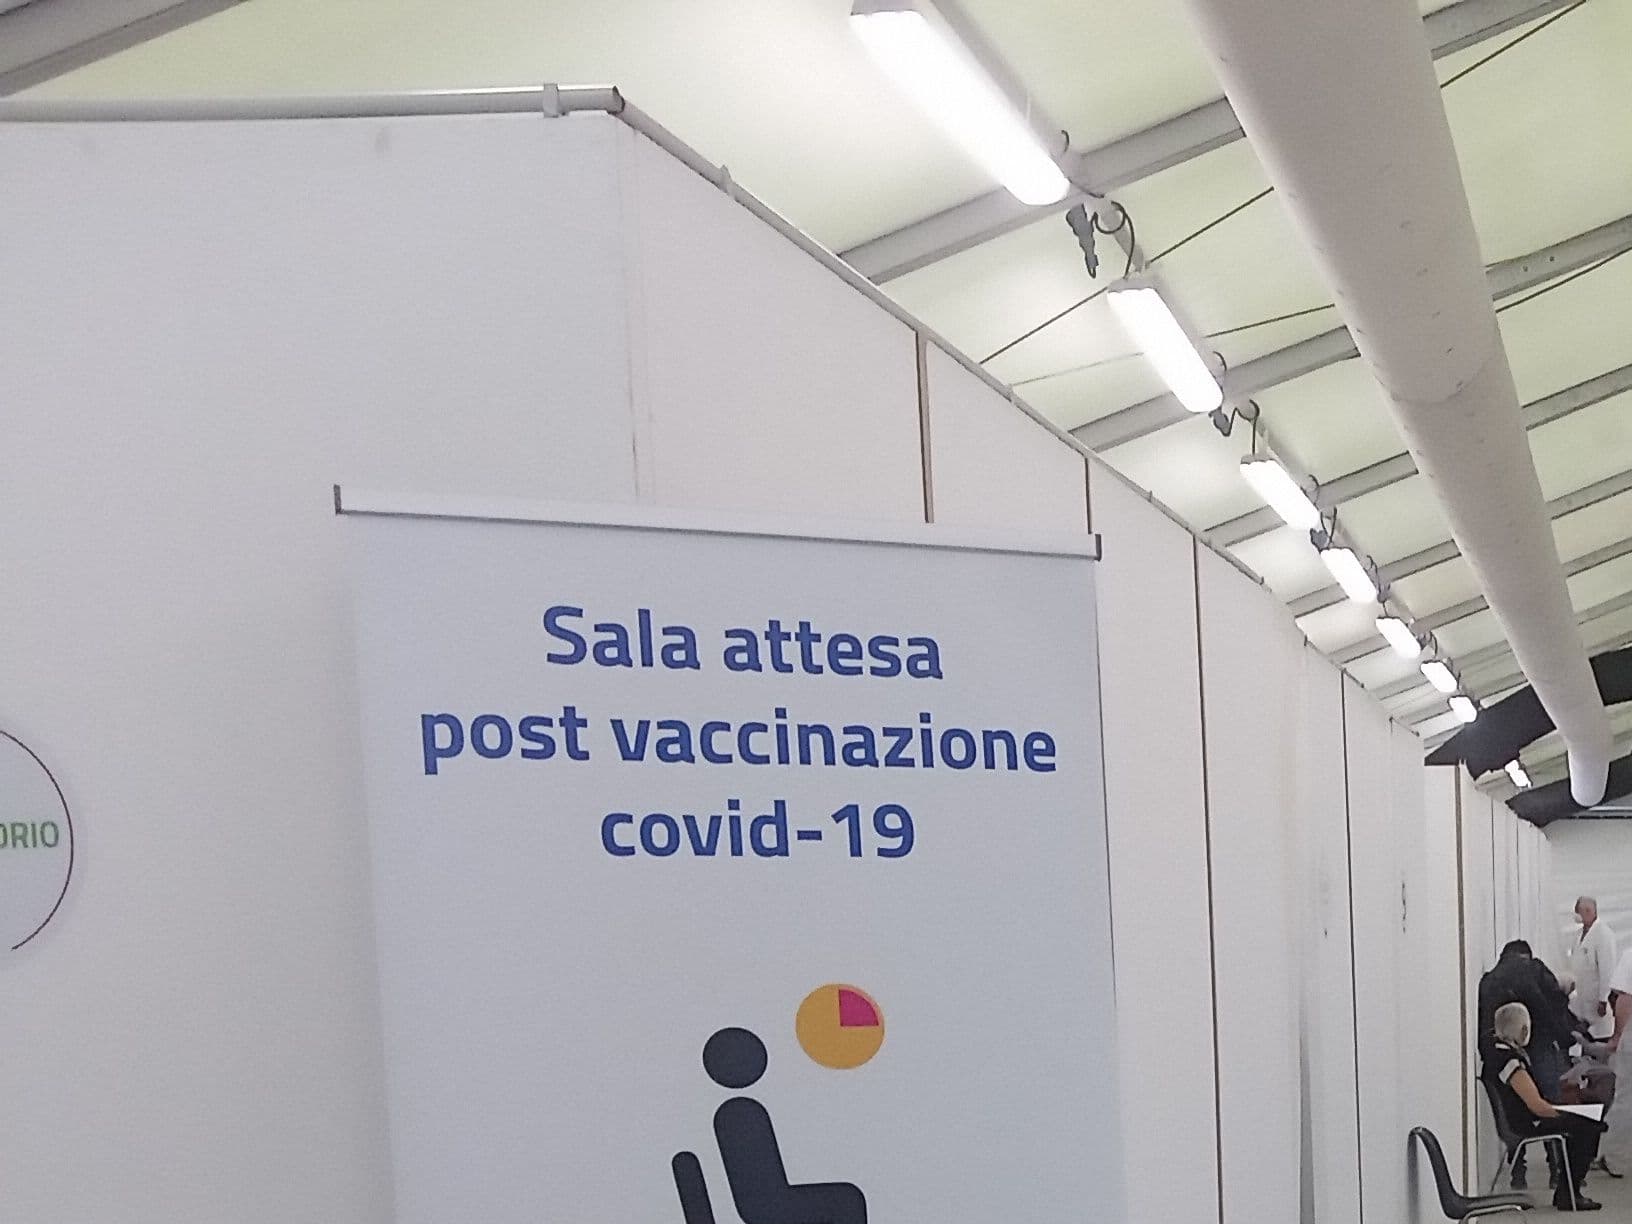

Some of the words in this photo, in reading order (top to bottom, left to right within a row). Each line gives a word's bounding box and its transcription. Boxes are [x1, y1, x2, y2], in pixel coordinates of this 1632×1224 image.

[543, 606, 700, 670] Sala
[724, 620, 944, 679] attesa
[421, 706, 589, 775] post
[610, 708, 1056, 772] vaccinazione
[601, 799, 915, 858] covid-19
